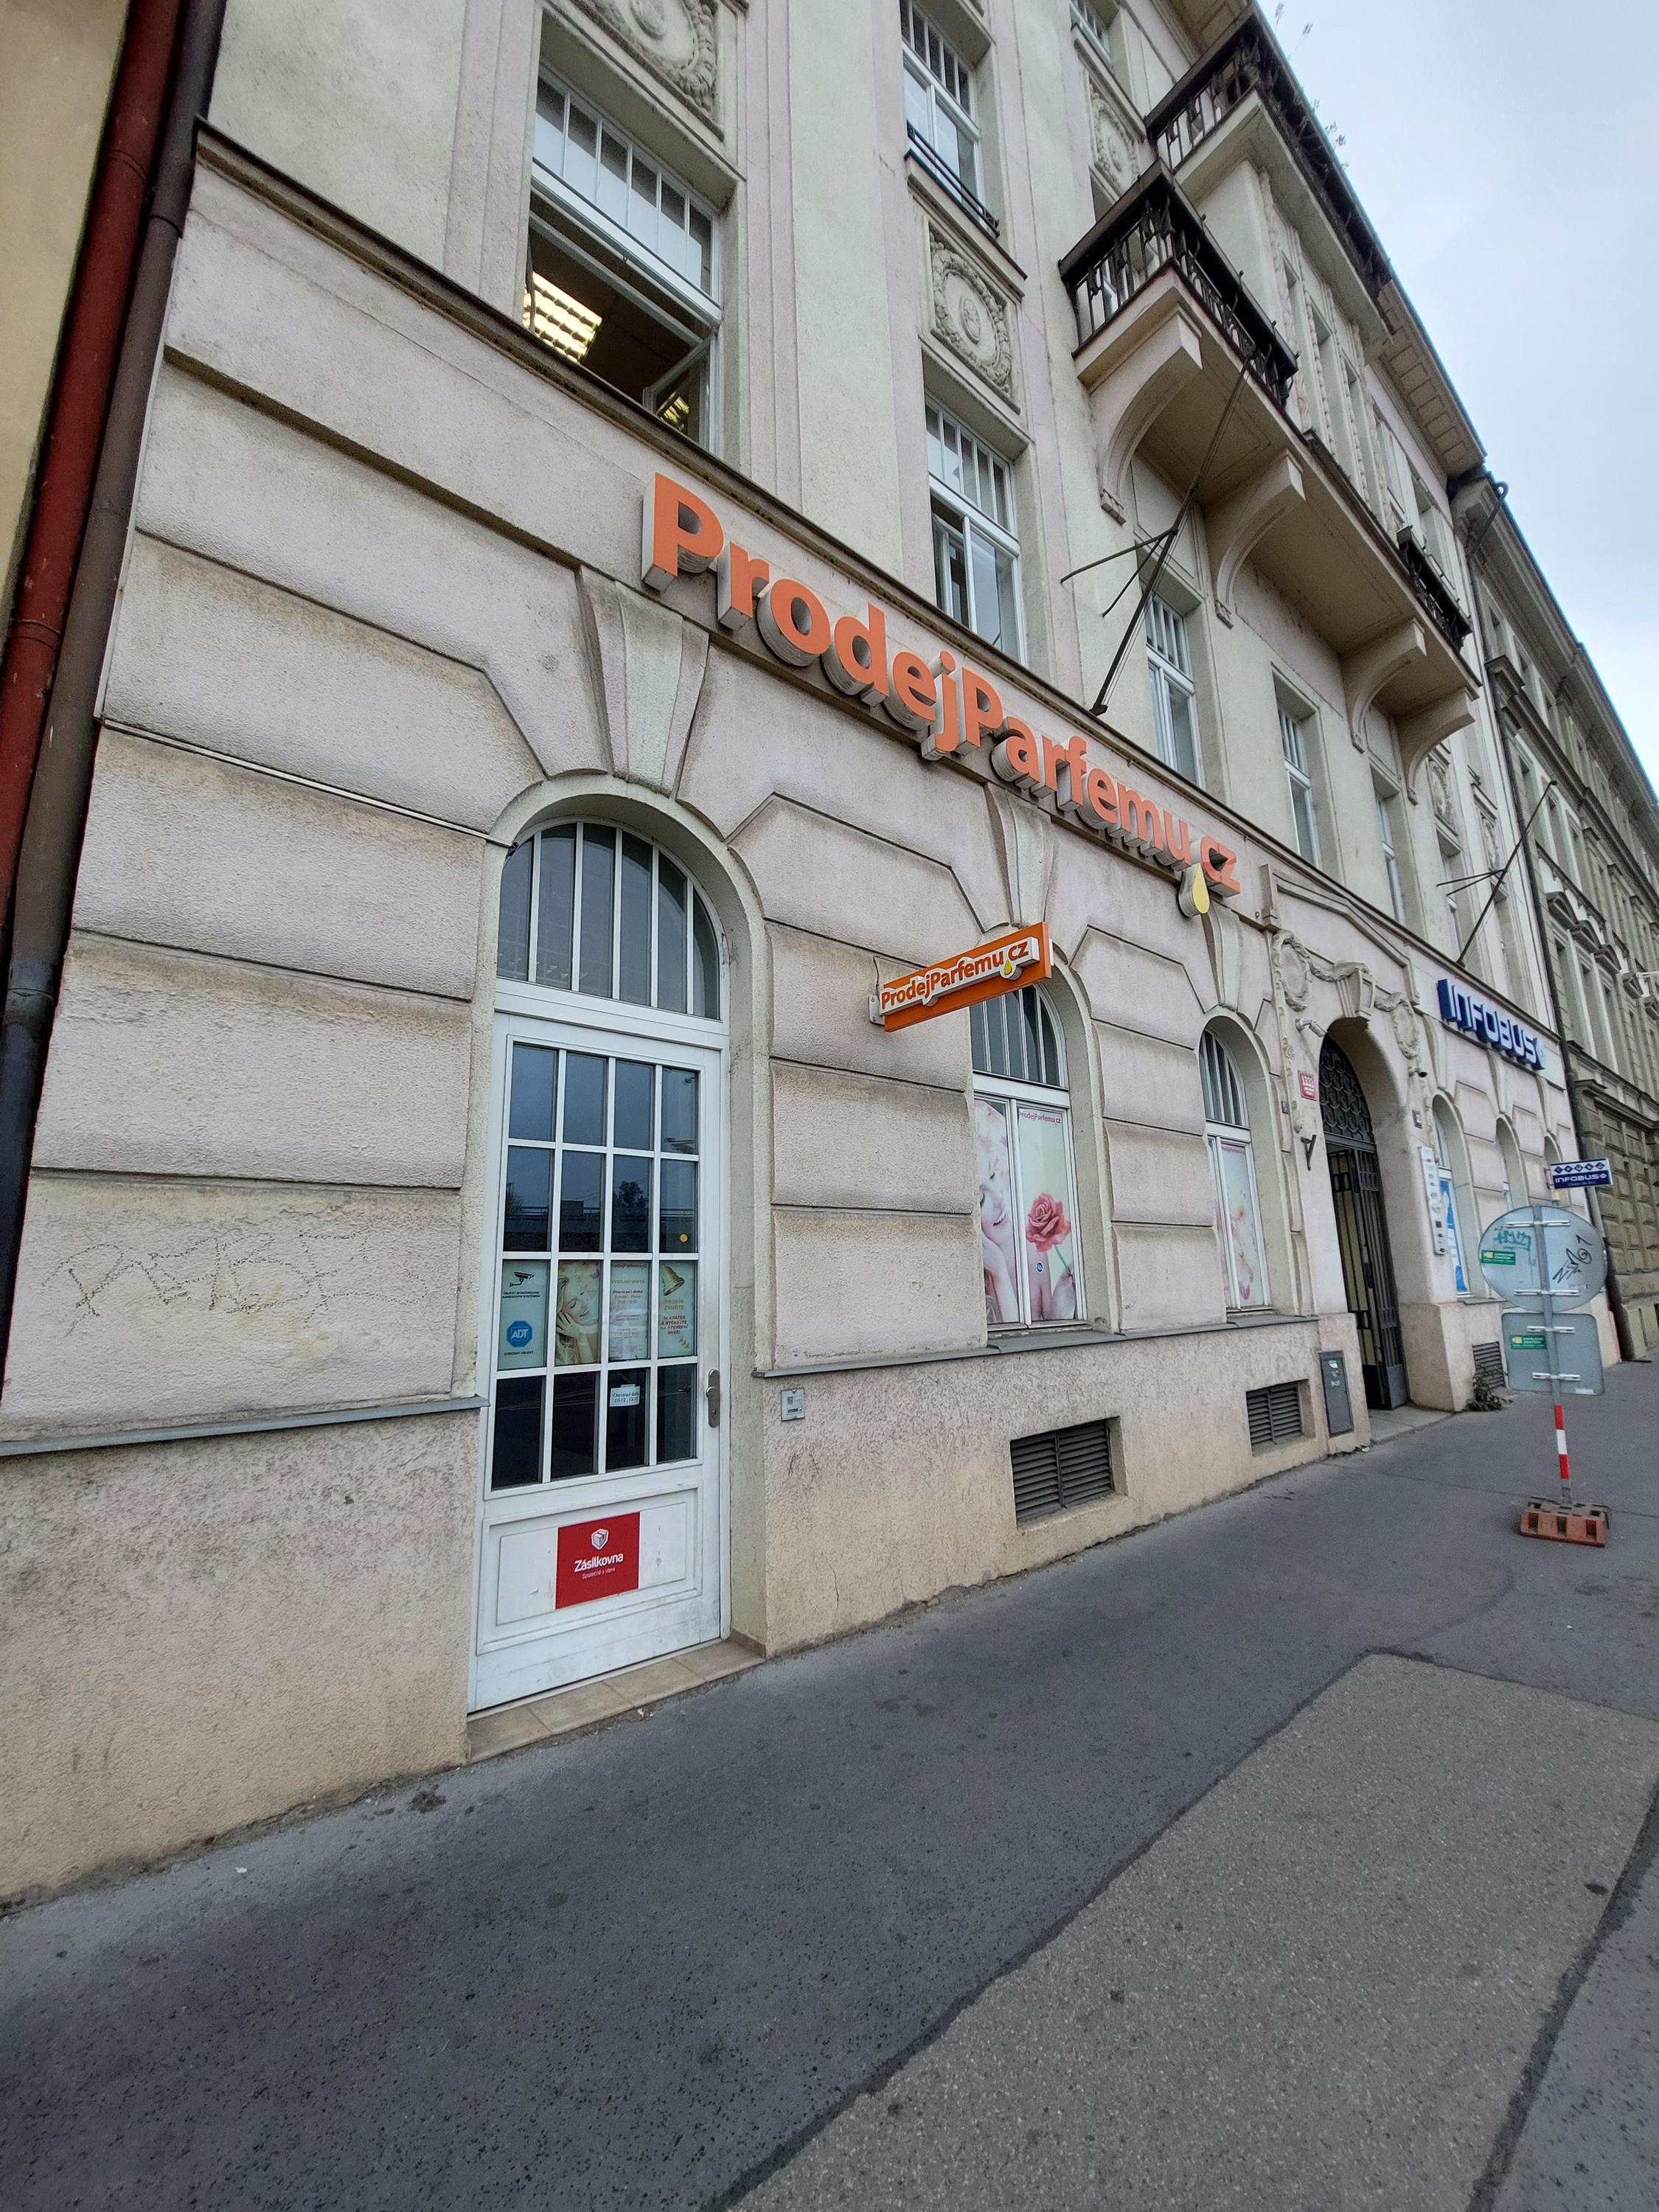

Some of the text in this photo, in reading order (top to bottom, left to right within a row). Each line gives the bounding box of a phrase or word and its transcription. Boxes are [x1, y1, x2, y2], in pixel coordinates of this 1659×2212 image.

[1555, 1173, 1600, 1183] INFOBUS
[510, 1329, 529, 1339] ADT
[574, 1553, 624, 1573] Zásilkovna
